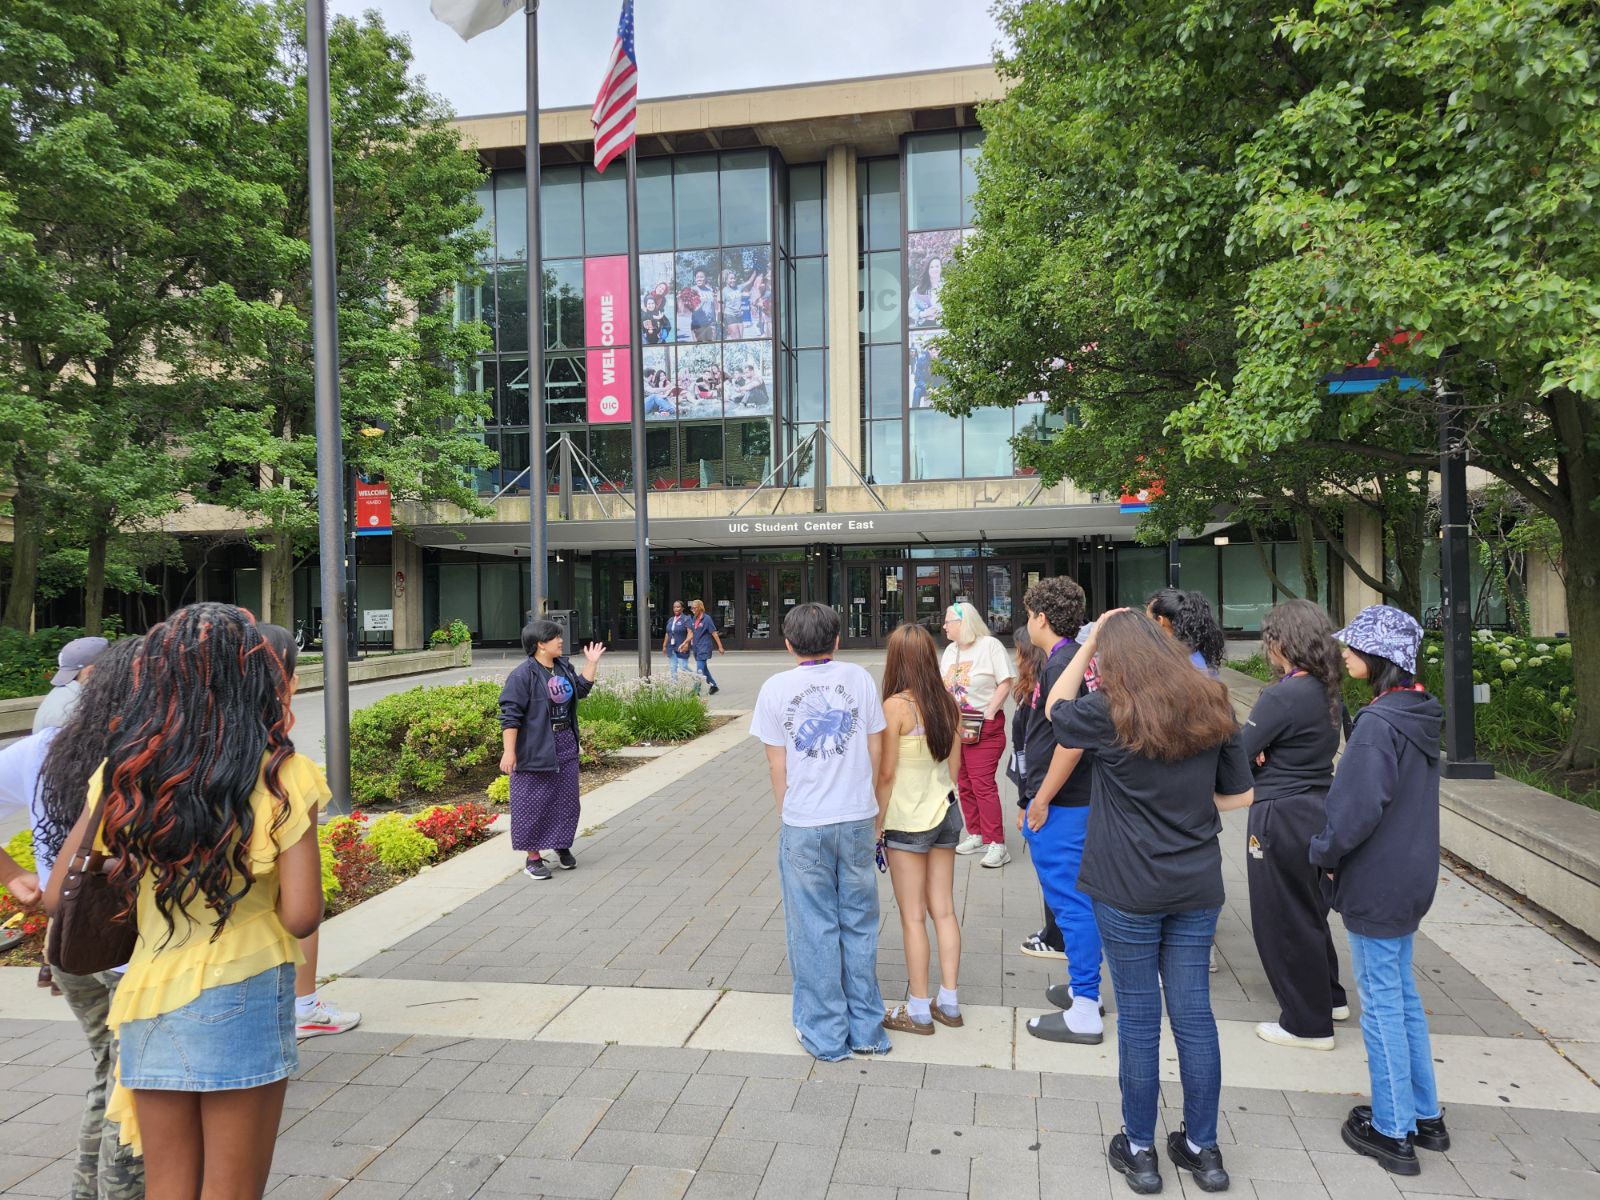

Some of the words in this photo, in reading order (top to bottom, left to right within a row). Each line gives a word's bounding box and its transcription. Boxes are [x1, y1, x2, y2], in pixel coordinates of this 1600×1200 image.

[601, 295, 615, 385] WELCOME
[358, 489, 388, 497] WELCOME
[728, 523, 749, 533] UIC
[754, 521, 799, 532] Student
[804, 520, 843, 531] Center
[848, 519, 874, 530] East
[550, 684, 571, 695] UIC
